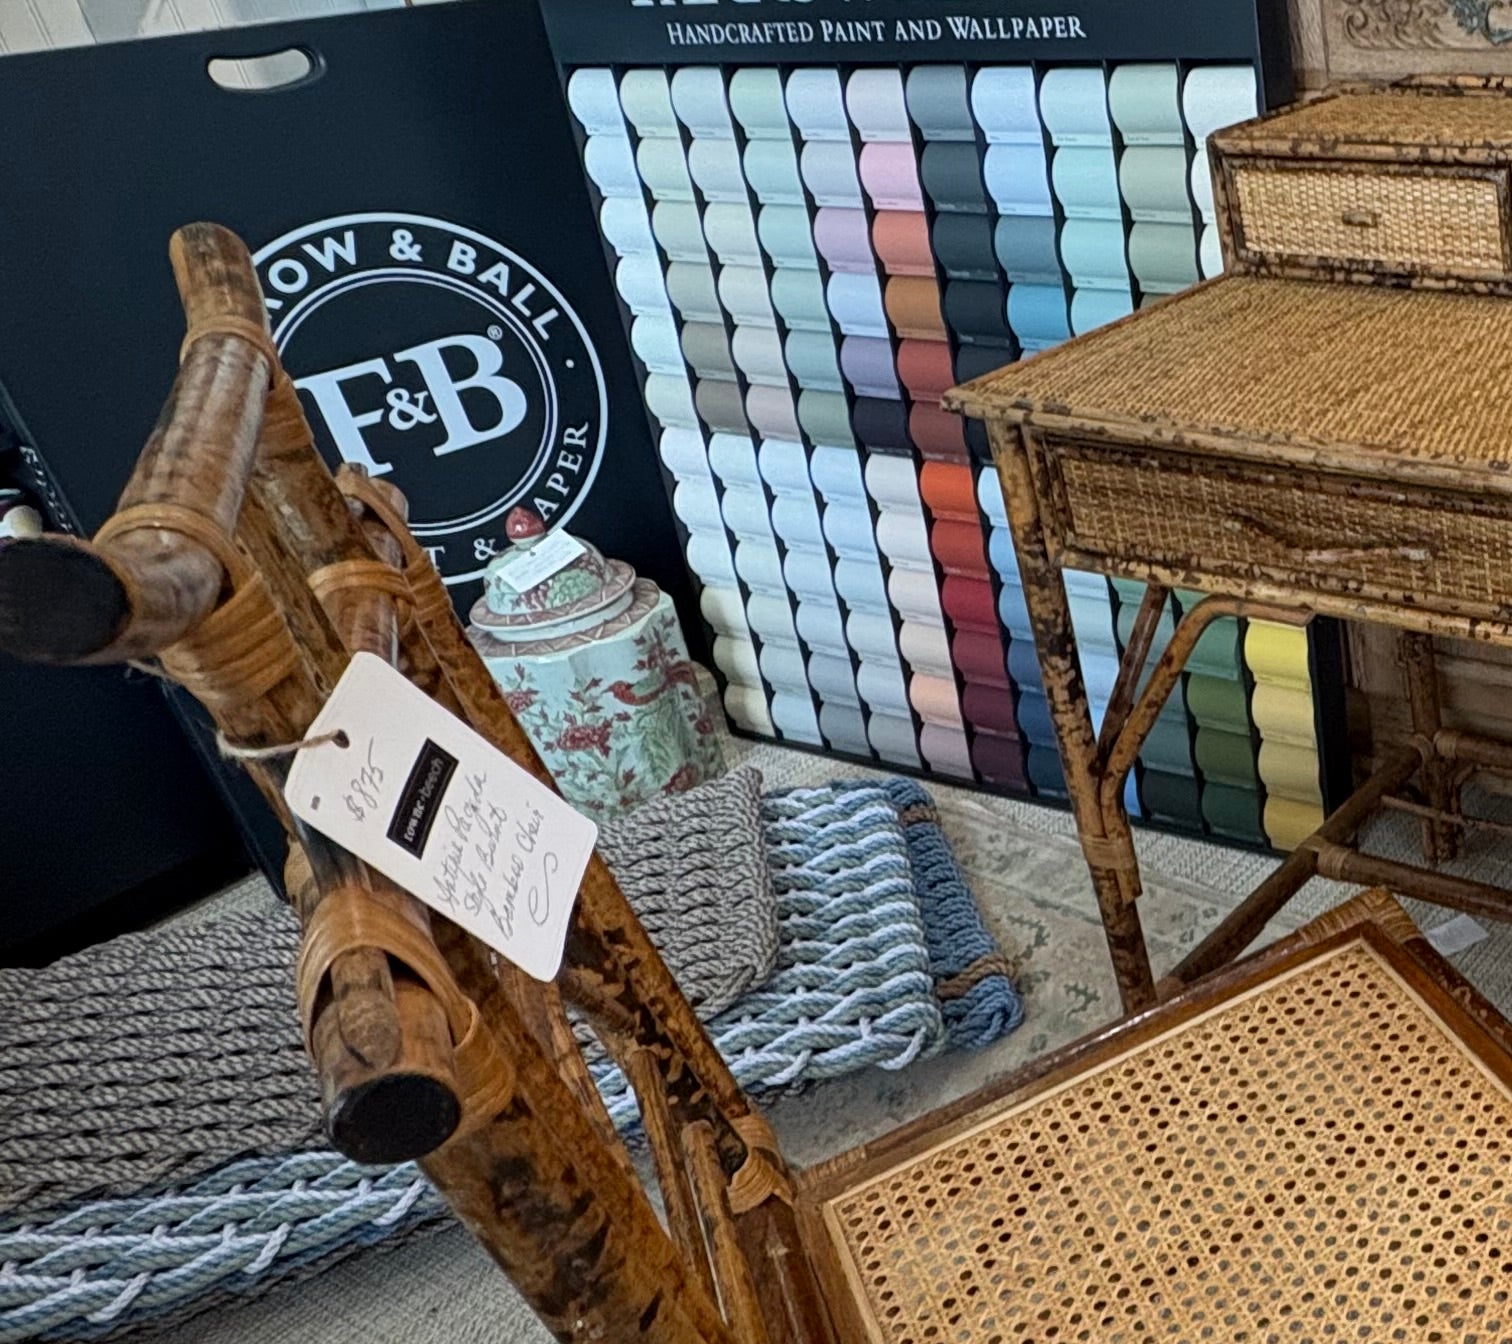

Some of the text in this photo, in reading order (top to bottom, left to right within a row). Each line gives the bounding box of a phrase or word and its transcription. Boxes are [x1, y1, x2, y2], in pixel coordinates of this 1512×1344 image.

[667, 14, 1087, 45] HANDCRAFTED PAINT AND WALLPAPER
[388, 228, 424, 263] &
[447, 239, 561, 342] BALL
[445, 771, 491, 842] Pagoda
[488, 802, 545, 941] Bamboo Chair
